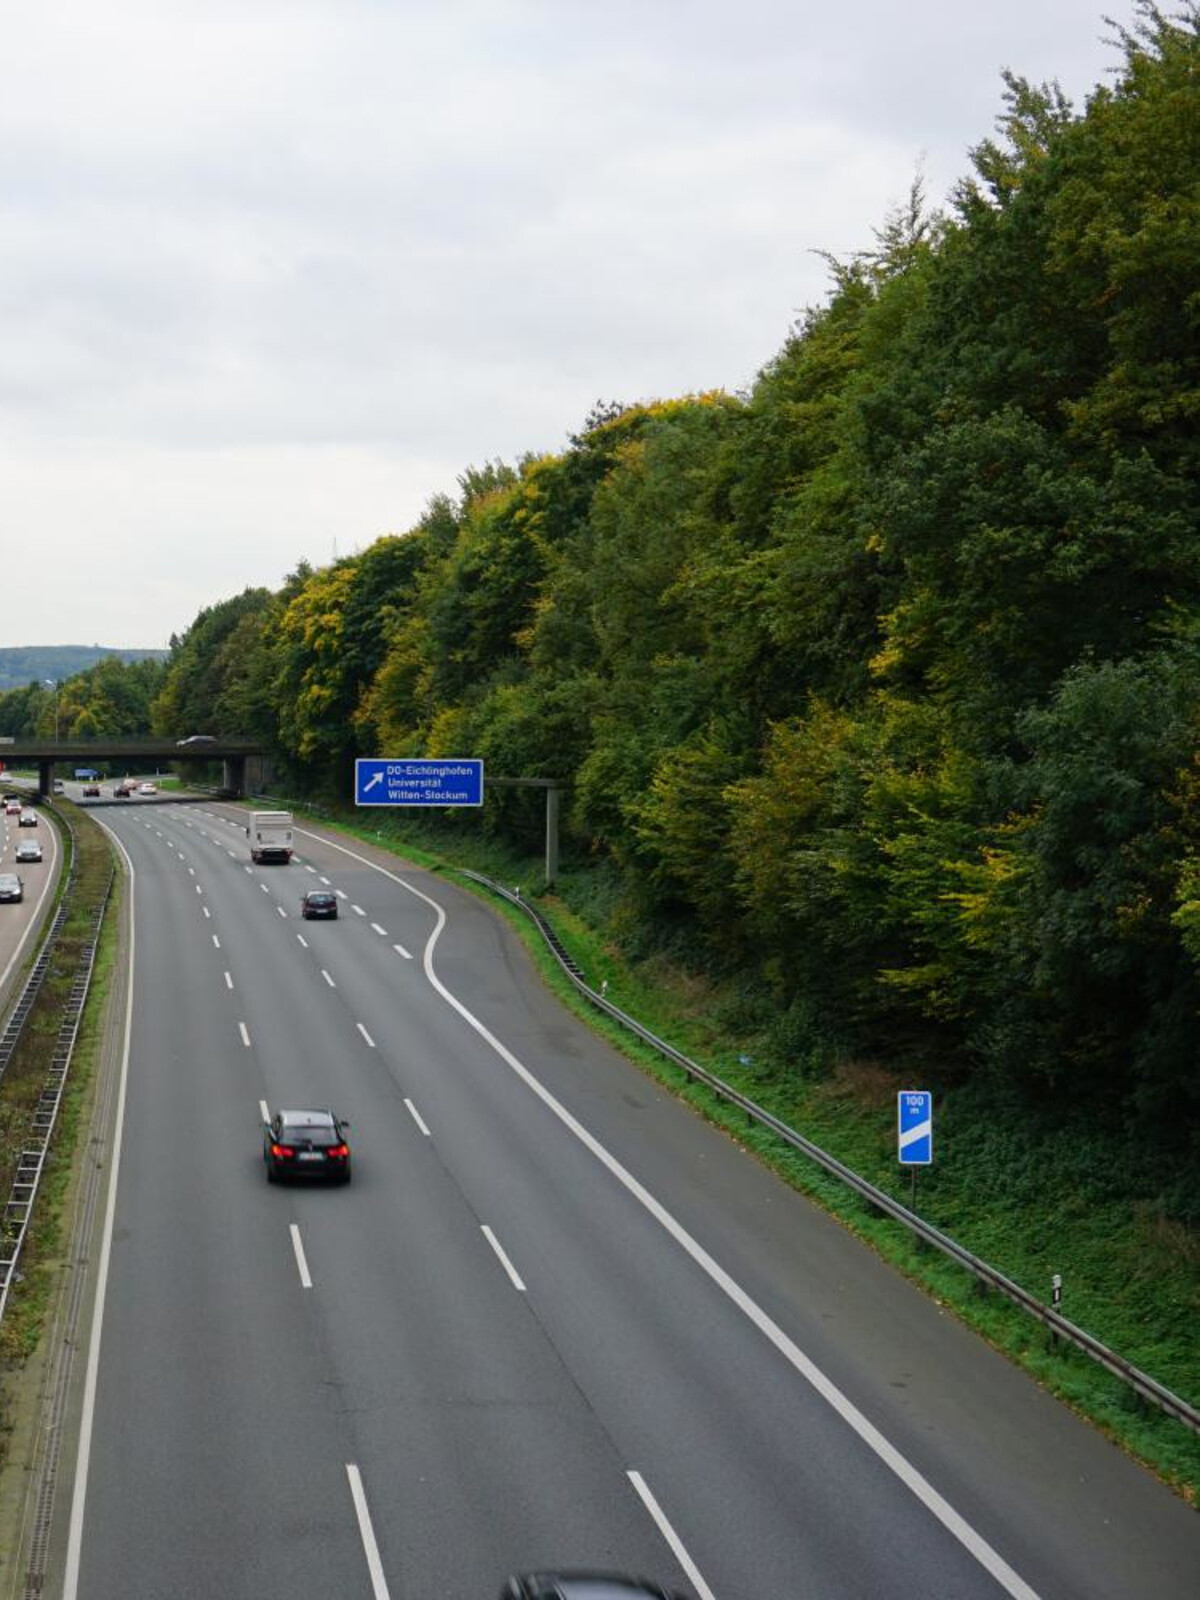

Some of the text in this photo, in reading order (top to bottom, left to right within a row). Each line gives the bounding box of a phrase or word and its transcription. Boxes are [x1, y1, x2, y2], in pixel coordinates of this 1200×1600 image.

[388, 777, 441, 788] Universität
[388, 790, 468, 799] Witten-Stockum
[906, 1095, 924, 1106] 100
